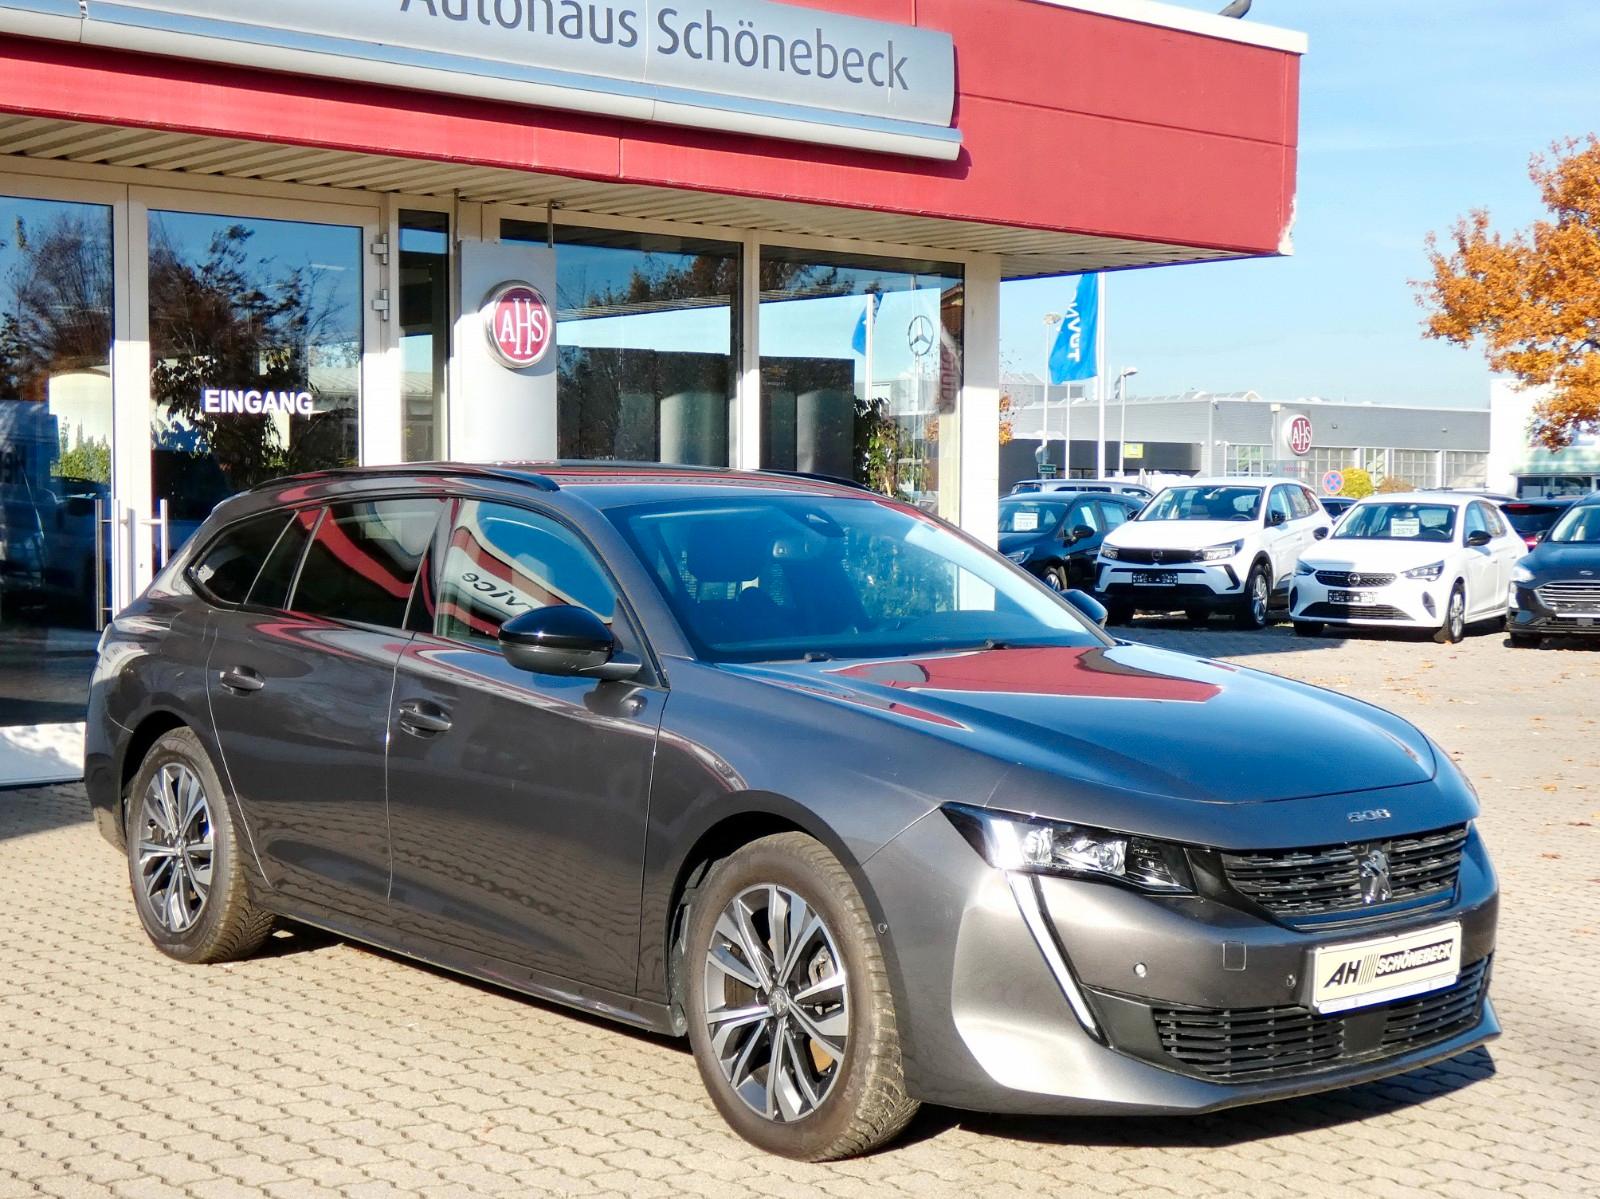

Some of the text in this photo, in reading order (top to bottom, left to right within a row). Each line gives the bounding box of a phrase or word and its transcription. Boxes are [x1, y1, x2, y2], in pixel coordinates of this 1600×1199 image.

[657, 7, 909, 91] Schönebeck
[499, 298, 544, 355] AHS
[204, 389, 313, 415] EINGANG
[1292, 420, 1311, 450] AHS
[1324, 941, 1453, 988] AH SCHÖNEBECK
